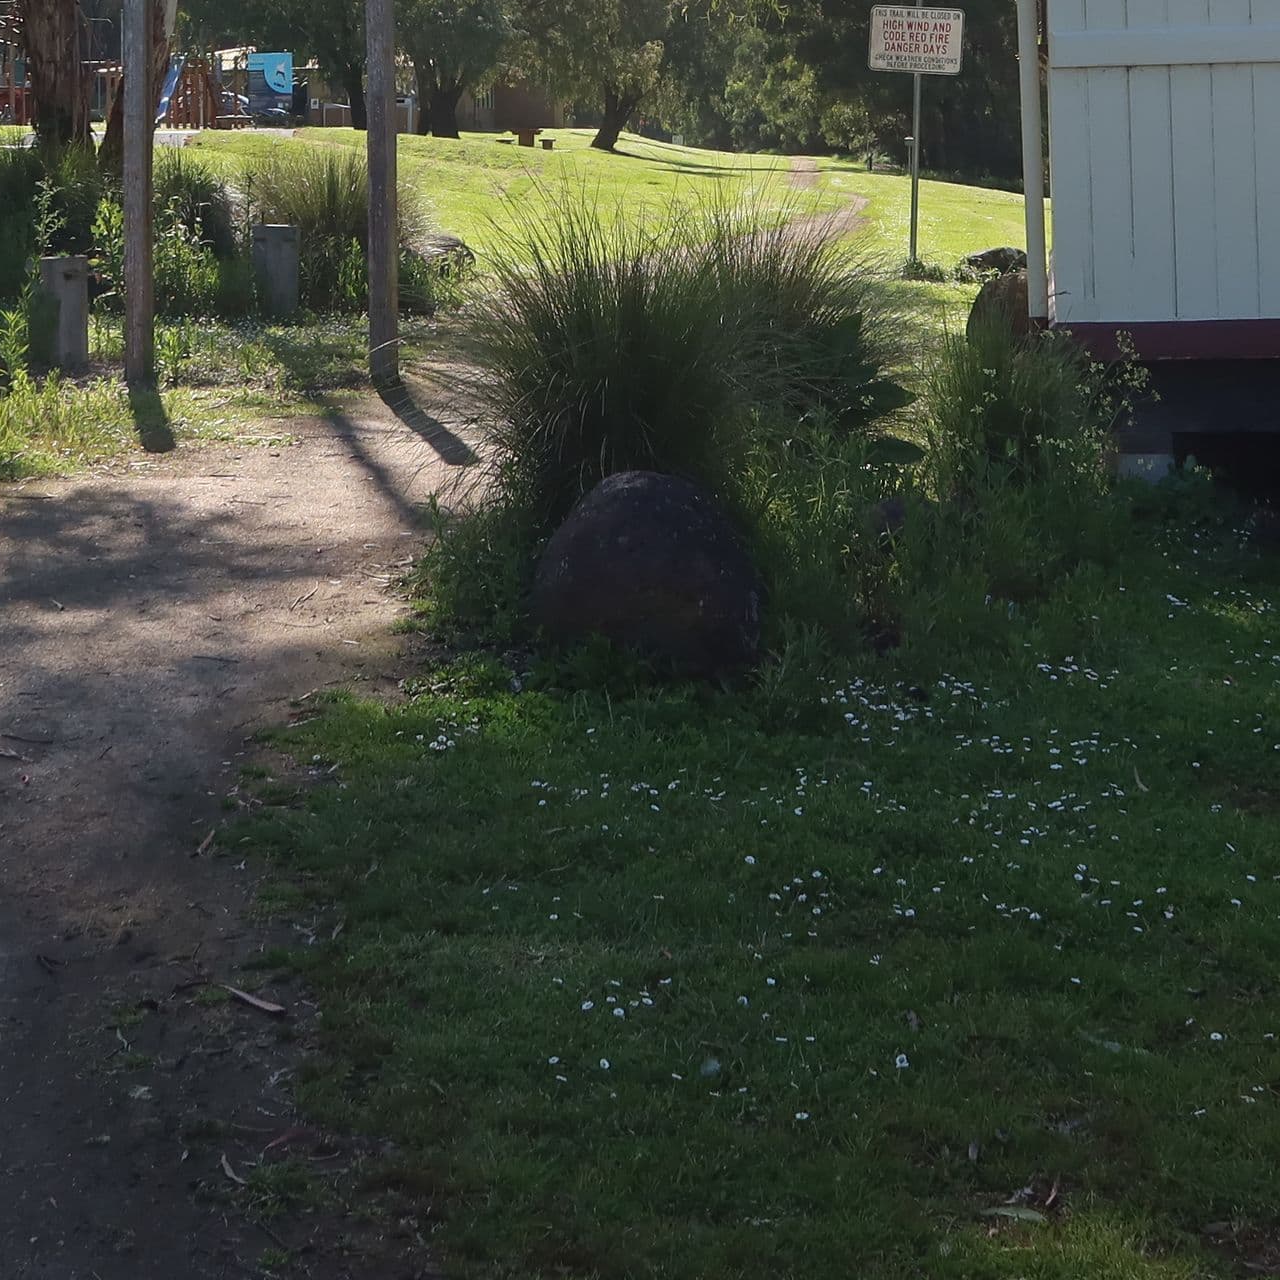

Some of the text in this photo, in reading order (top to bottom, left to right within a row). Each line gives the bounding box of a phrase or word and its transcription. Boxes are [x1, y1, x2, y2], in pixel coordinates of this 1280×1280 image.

[875, 9, 961, 20] THIS TRAIL WILL BE CLOSED ON
[882, 20, 952, 33] HIGH WIND AND
[883, 30, 950, 44] CODE RED FIRE
[884, 41, 947, 55] DANGER DAYS
[910, 62, 946, 70] PROCEEDING
[923, 56, 958, 65] CONDITIONS
